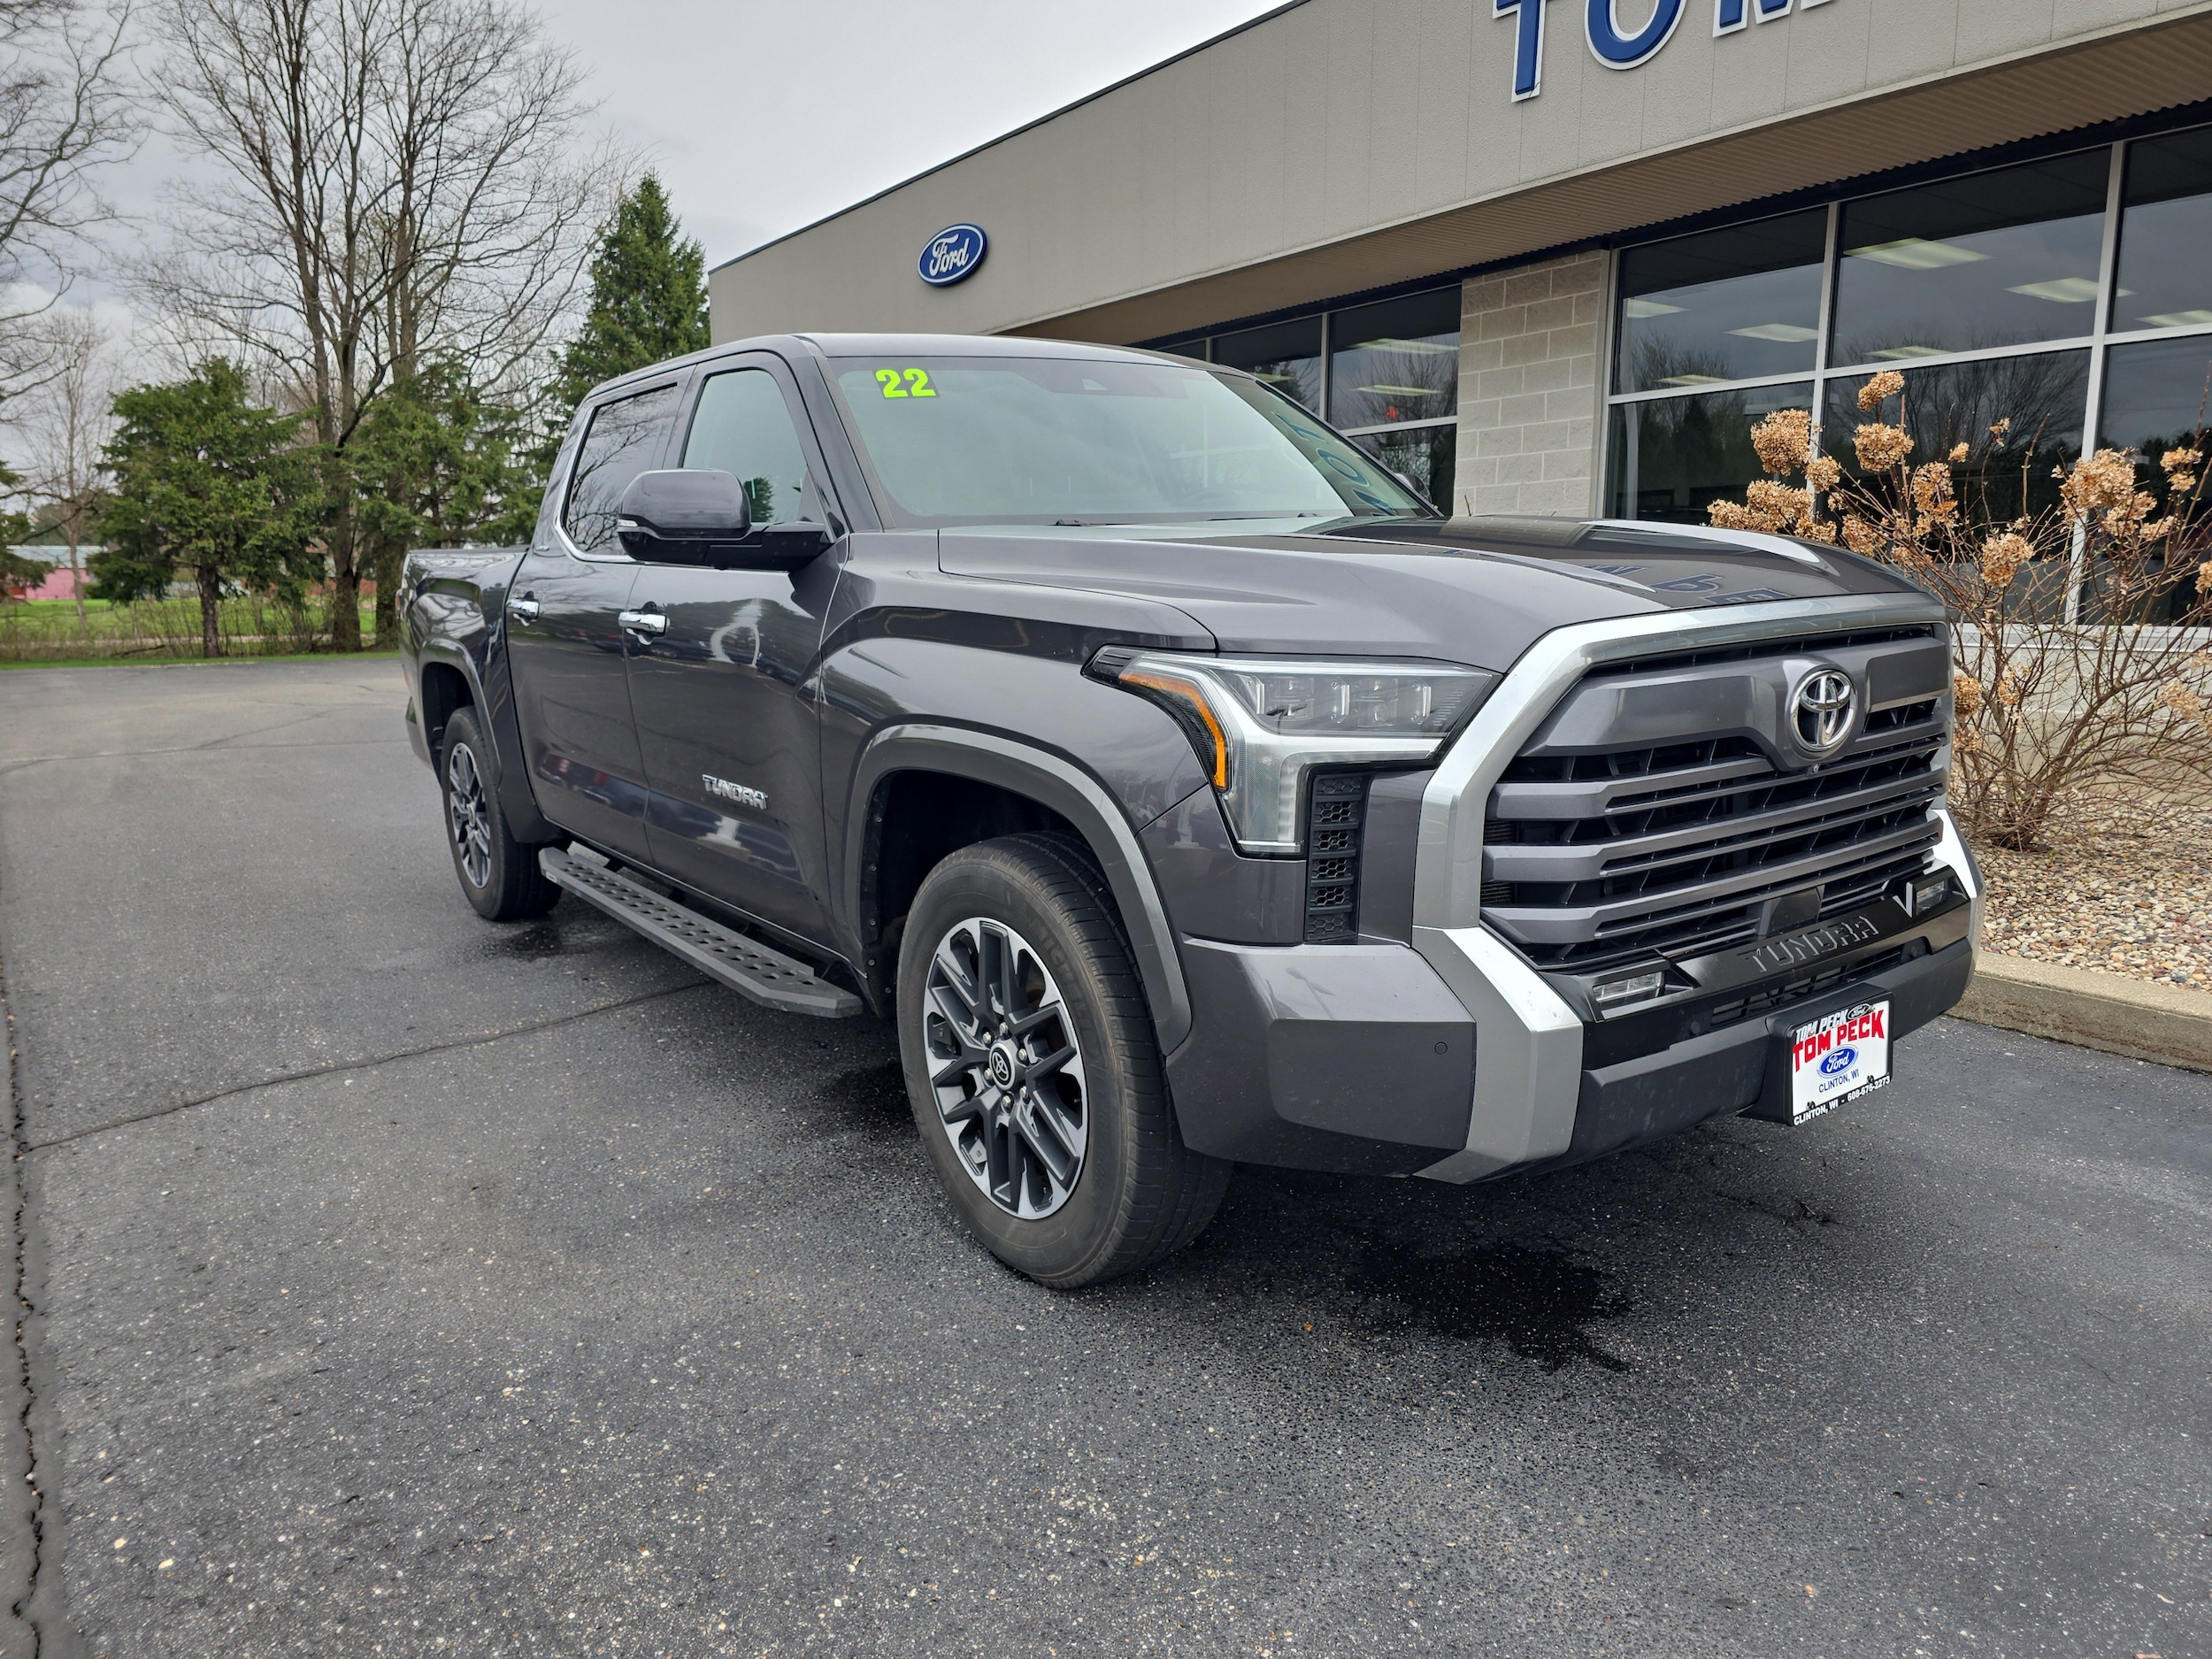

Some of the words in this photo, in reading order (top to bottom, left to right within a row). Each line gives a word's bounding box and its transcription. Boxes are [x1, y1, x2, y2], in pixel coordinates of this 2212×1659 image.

[929, 234, 970, 276] Ford
[875, 368, 936, 398] 22
[703, 774, 768, 810] TUNDRA
[1737, 915, 1878, 973] TUNDRA
[1793, 1030, 1831, 1072] TOM
[1837, 1010, 1885, 1046] PECK
[1795, 1020, 1818, 1041] TOM
[1818, 1009, 1848, 1032] PECK
[1826, 1050, 1850, 1073] Ford
[1818, 1073, 1850, 1093] CLINTON,
[1851, 1068, 1860, 1079] WI
[1793, 1105, 1828, 1126] CLINTON,
[1829, 1098, 1839, 1110] WI
